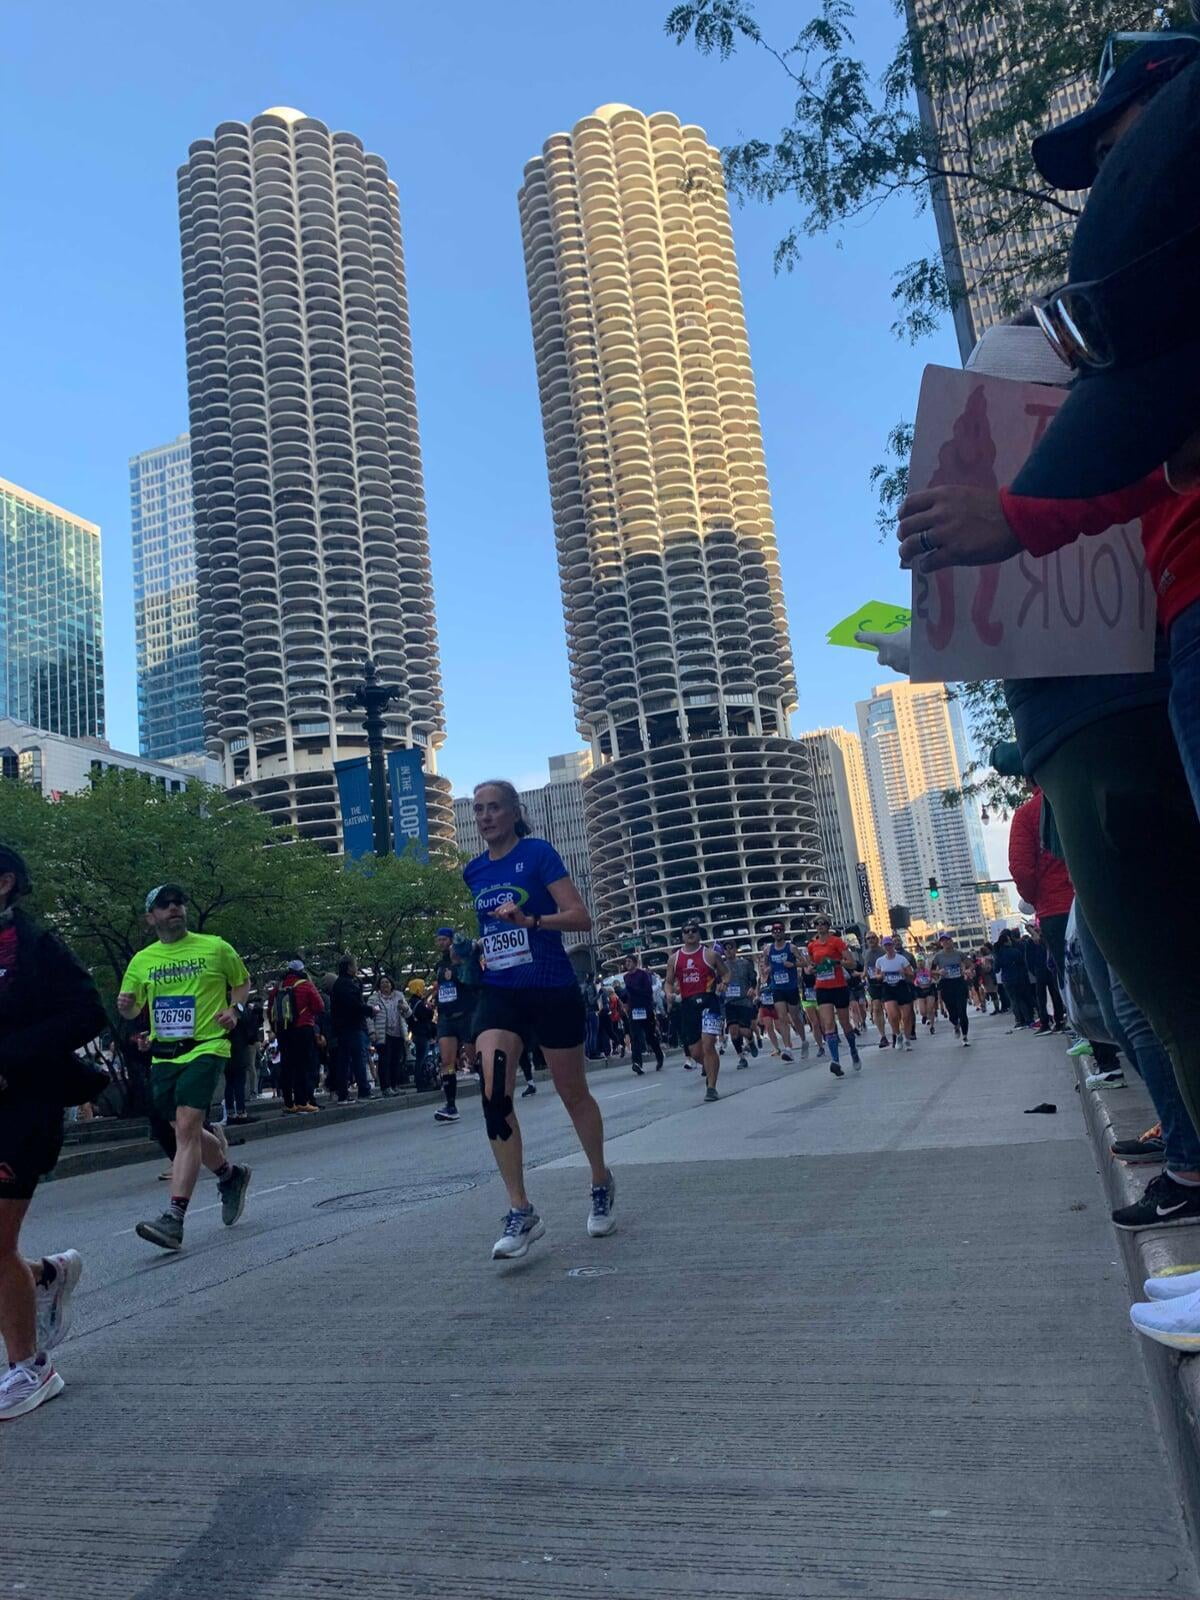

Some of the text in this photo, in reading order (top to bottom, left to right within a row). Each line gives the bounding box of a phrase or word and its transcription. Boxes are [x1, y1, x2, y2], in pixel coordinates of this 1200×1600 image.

[400, 766, 412, 791] IN THE
[344, 815, 369, 827] GATEWAY
[351, 807, 361, 815] THE
[399, 795, 420, 838] LOOP
[860, 874, 872, 914] CHICAGO
[492, 930, 525, 952] 25960
[148, 958, 207, 979] THUNDER
[161, 1009, 192, 1023] 26796
